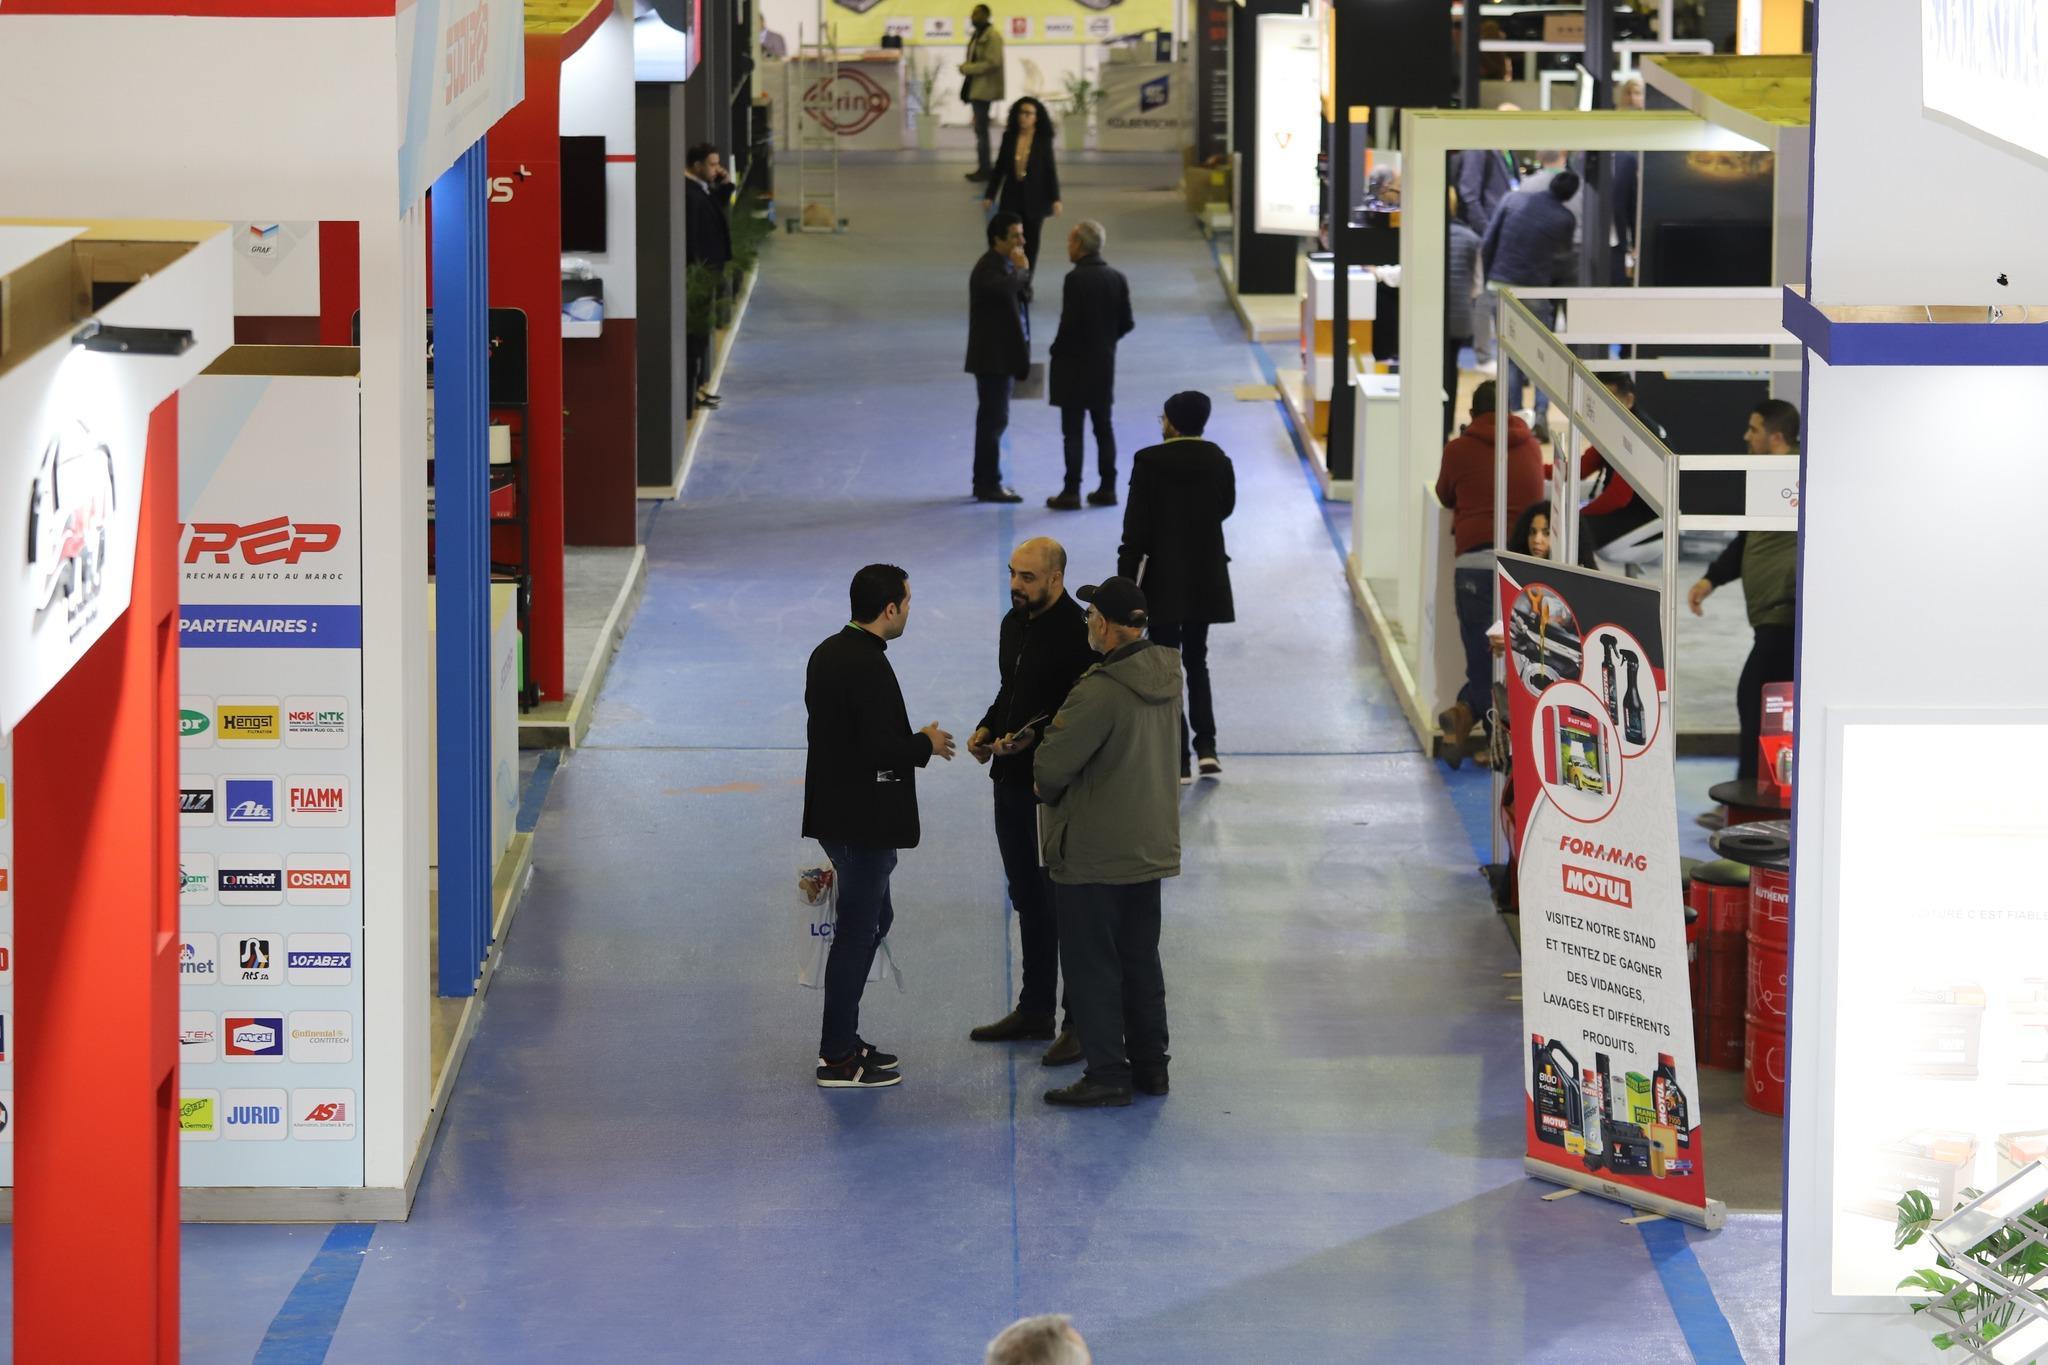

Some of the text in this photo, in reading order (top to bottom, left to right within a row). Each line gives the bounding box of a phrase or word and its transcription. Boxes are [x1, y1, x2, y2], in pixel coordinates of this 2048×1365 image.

[186, 572, 343, 580] RECHANGE AUTO AU MAROC
[224, 715, 273, 729] Hengst
[289, 711, 344, 721] NGK NTK
[290, 788, 343, 808] FIAMM
[1560, 835, 1647, 872] FORAMAG
[290, 873, 348, 886] OSRAM
[1566, 869, 1630, 904] MOTUL
[1545, 910, 1656, 949] VISITEZ NOTRE STAND
[290, 955, 350, 967] SOFABEX
[1546, 938, 1663, 980] ET TENTEZ DE GAGNER
[1567, 970, 1645, 1003] DES VIDANGES,
[1543, 992, 1671, 1037] LAVAGES ET DIFFÉRENTS
[291, 1029, 336, 1039] Continental
[1583, 1029, 1638, 1055] PRODUITS.
[227, 1106, 280, 1124] JURID
